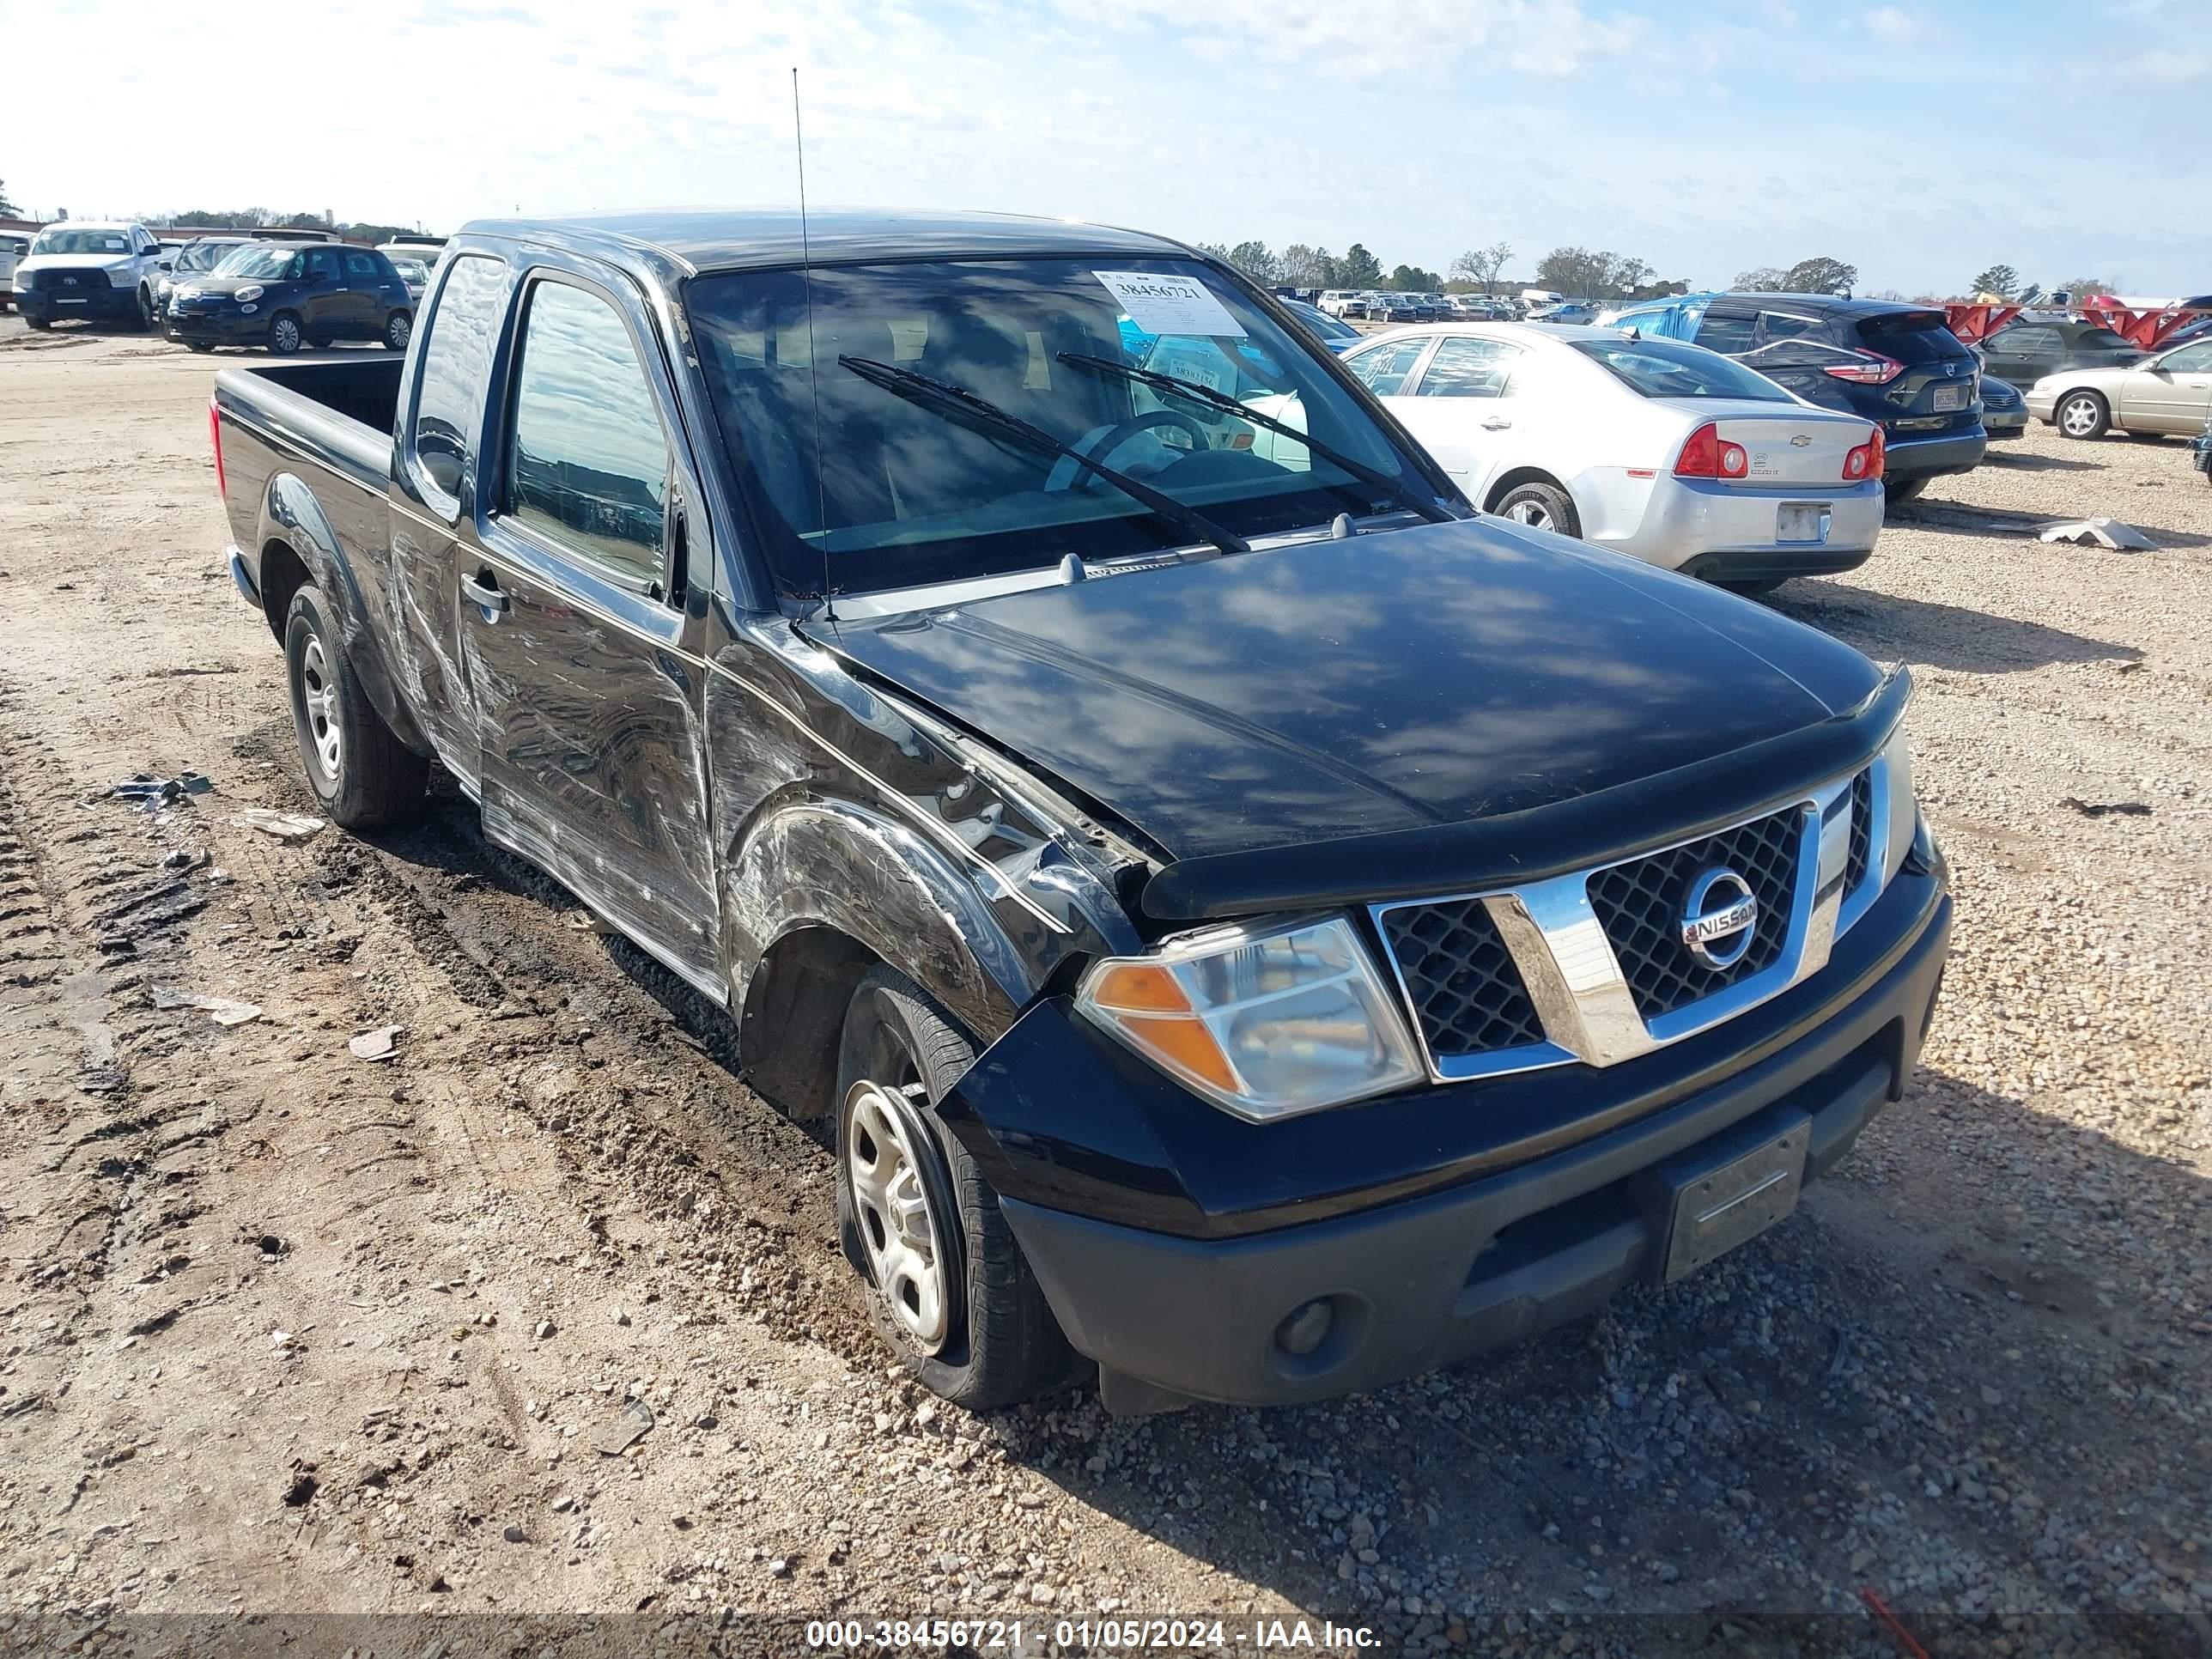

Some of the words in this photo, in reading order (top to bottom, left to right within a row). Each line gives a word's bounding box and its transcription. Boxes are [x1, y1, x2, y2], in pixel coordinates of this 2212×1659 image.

[1116, 283, 1202, 299] 38456721
[1174, 367, 1212, 386] 38382156
[1698, 902, 1756, 937] NISSAN
